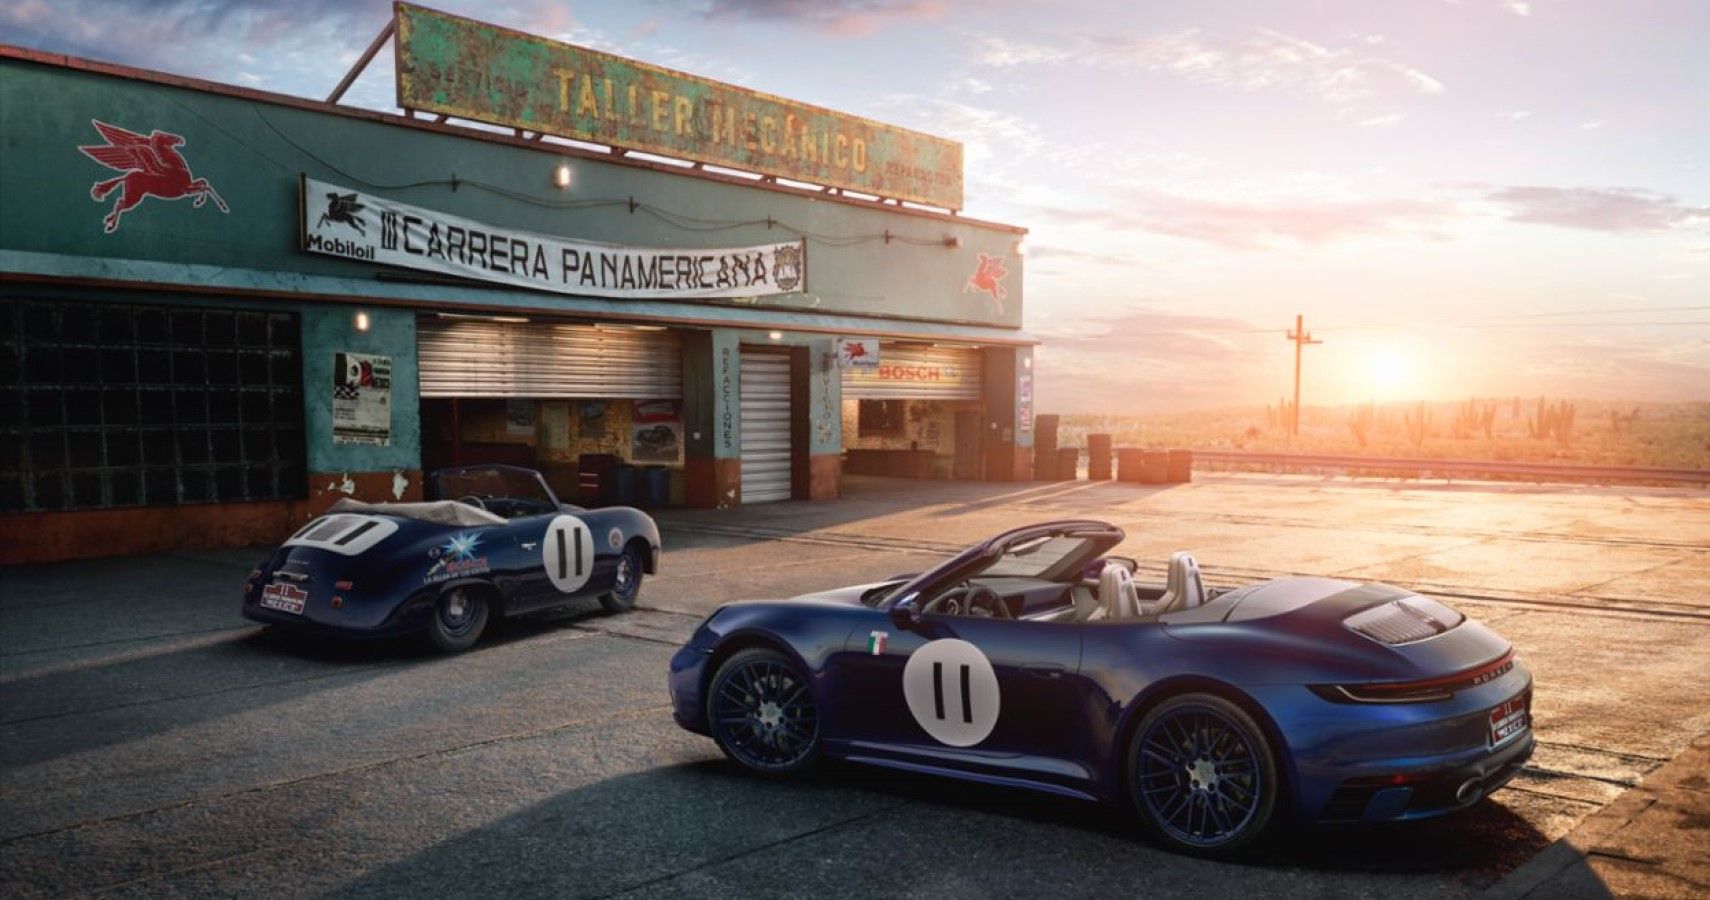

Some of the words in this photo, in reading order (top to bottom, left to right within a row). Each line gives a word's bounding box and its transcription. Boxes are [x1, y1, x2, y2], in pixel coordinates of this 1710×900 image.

[553, 68, 694, 136] TALLER
[307, 233, 375, 261] Mobiloil
[402, 217, 549, 281] CARRERA
[562, 248, 769, 291] PANAMERICANA
[722, 348, 732, 449] REFACCIONES
[879, 366, 939, 380] BOSCH
[556, 527, 583, 579] 11
[933, 662, 973, 723] 11
